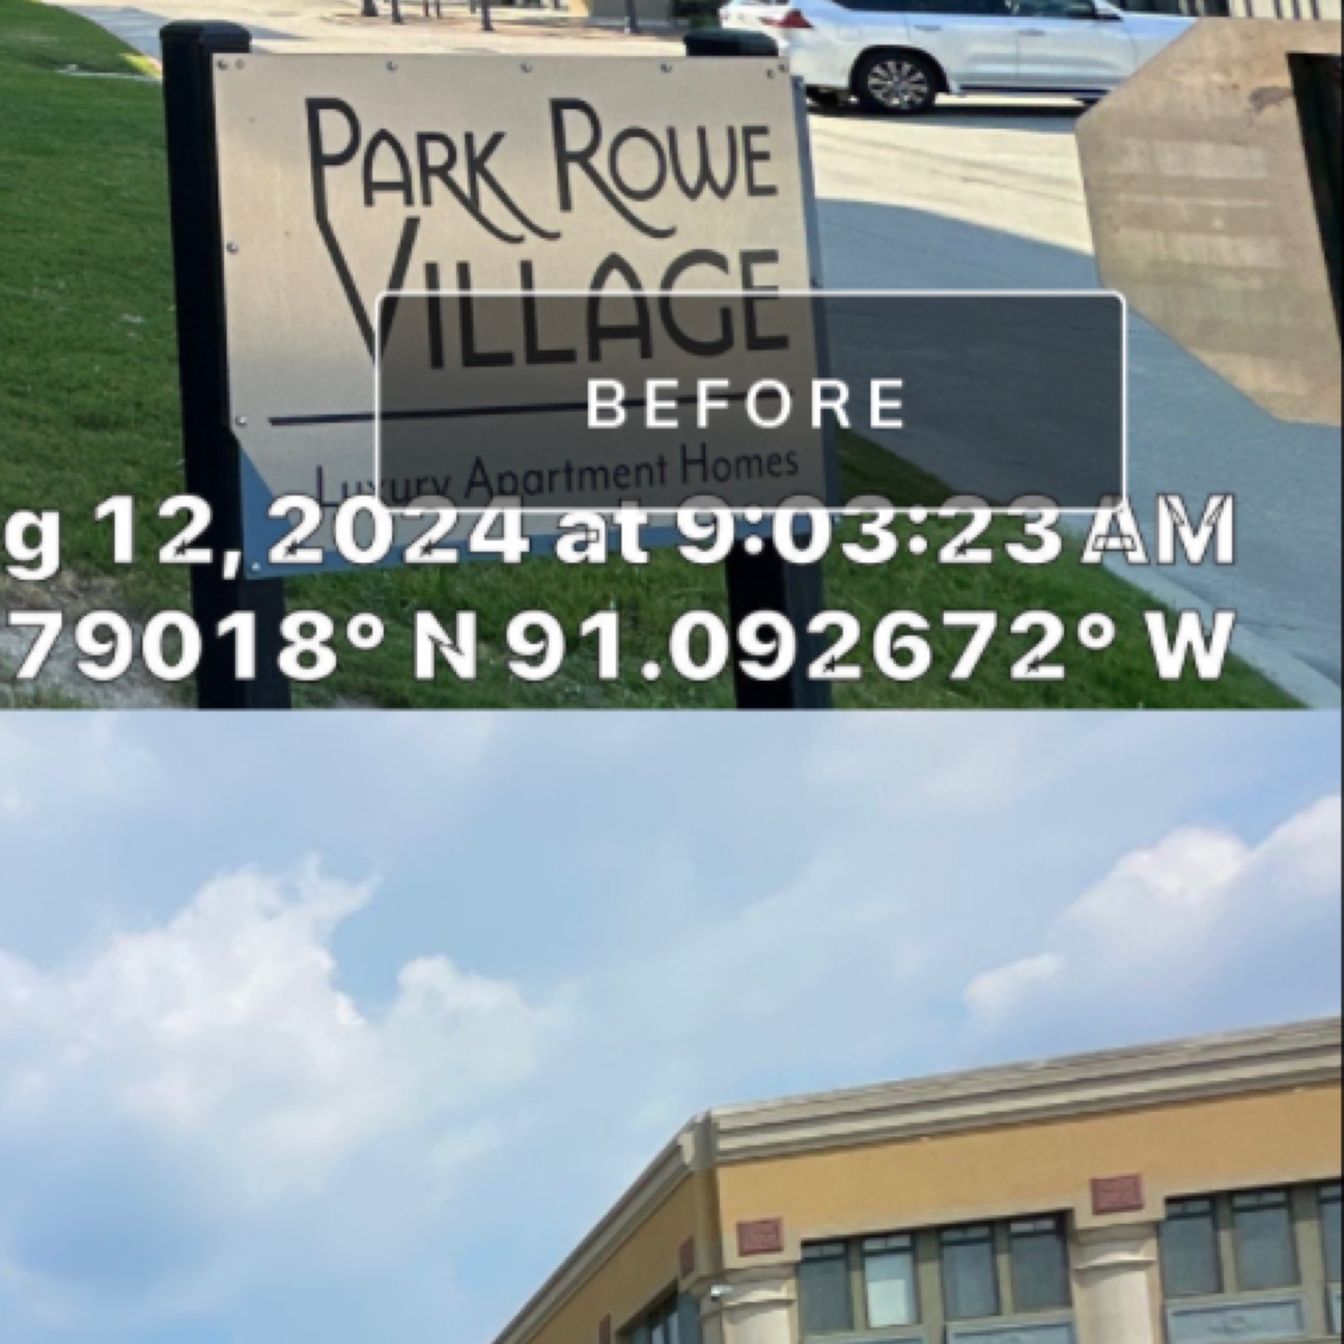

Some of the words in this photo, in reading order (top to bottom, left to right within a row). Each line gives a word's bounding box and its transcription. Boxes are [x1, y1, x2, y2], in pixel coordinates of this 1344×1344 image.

[305, 97, 560, 243] PARK
[548, 97, 778, 238] ROWE
[316, 215, 790, 370] VILLAGE
[463, 453, 668, 506] Apartment
[679, 443, 799, 485] Homes
